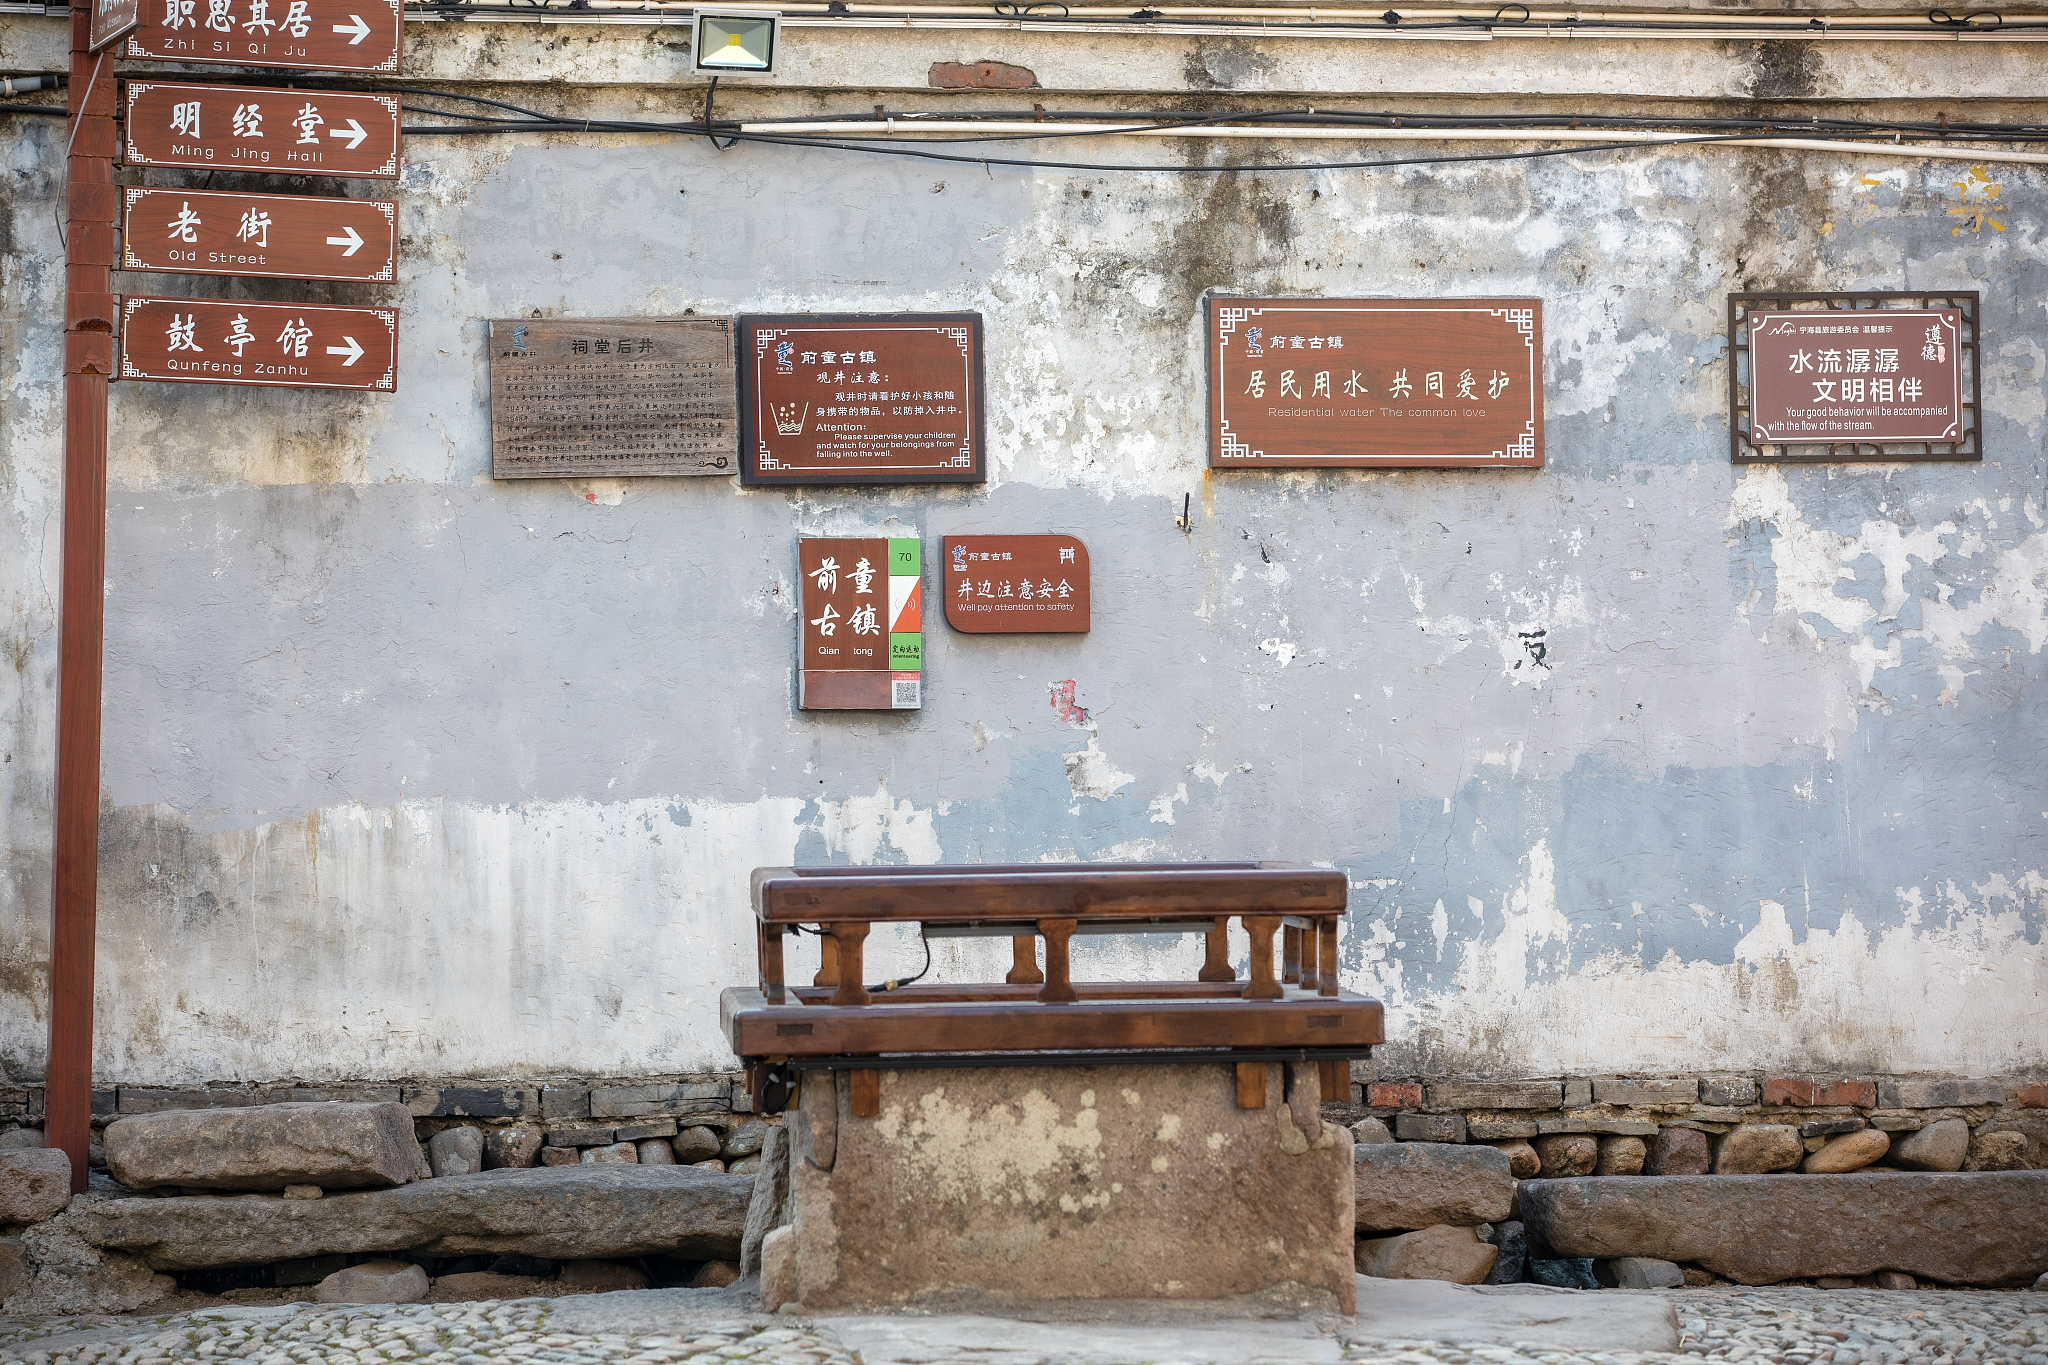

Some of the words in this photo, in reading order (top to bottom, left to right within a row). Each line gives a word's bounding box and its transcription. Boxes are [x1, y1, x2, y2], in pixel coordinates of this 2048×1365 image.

[164, 39, 195, 50] Zhi
[213, 42, 229, 51] Si
[249, 43, 265, 54] Qi
[284, 45, 306, 57] Ju
[170, 102, 324, 144] 明经堂
[172, 145, 214, 159] Ming
[232, 148, 269, 162] Jing
[288, 150, 323, 162] Hall
[168, 201, 272, 247] 老街
[170, 250, 195, 261] Old
[209, 252, 265, 264] Street
[166, 313, 313, 358] 鼓亭馆
[1800, 326, 1859, 334] 宁海县旅游委员会
[572, 339, 653, 356] 祠堂后井
[1270, 335, 1343, 348] 前童古镇
[801, 350, 876, 364] 前童古镇
[1789, 349, 1899, 373] 水流潺潺
[168, 359, 241, 375] Qunfeng
[255, 364, 307, 375] Zanhu
[1244, 370, 1368, 399] 居民用水
[1389, 368, 1509, 400] 共同爱护
[1813, 377, 1922, 402] 文明相伴
[836, 391, 954, 401] 观井时请看护好小孩和随
[1269, 408, 1333, 416] Residential
[1380, 408, 1402, 416] The
[1786, 407, 1805, 417] Your
[1807, 407, 1827, 419] good
[1829, 407, 1864, 416] behavior
[1866, 406, 1879, 416] will
[1882, 406, 1891, 415] be
[1894, 406, 1947, 417] accompanied
[816, 423, 866, 431] Attention:
[1768, 421, 1784, 430] with
[1787, 421, 1799, 430] the
[1802, 421, 1817, 430] flow
[1820, 420, 1827, 430] of
[1829, 421, 1842, 430] the
[1844, 421, 1874, 430] stream.
[864, 433, 902, 441] supervise
[904, 433, 922, 441] your
[891, 441, 935, 449] belongings
[936, 440, 954, 448] from
[899, 553, 911, 561] 70
[968, 552, 1012, 561] 前童古镇
[808, 557, 876, 594] 前童
[958, 578, 1074, 601] 井边注意安全
[1047, 603, 1074, 611] safety
[811, 604, 880, 636] 古镇
[853, 648, 872, 656] tong
[893, 645, 919, 653] 定向运动
